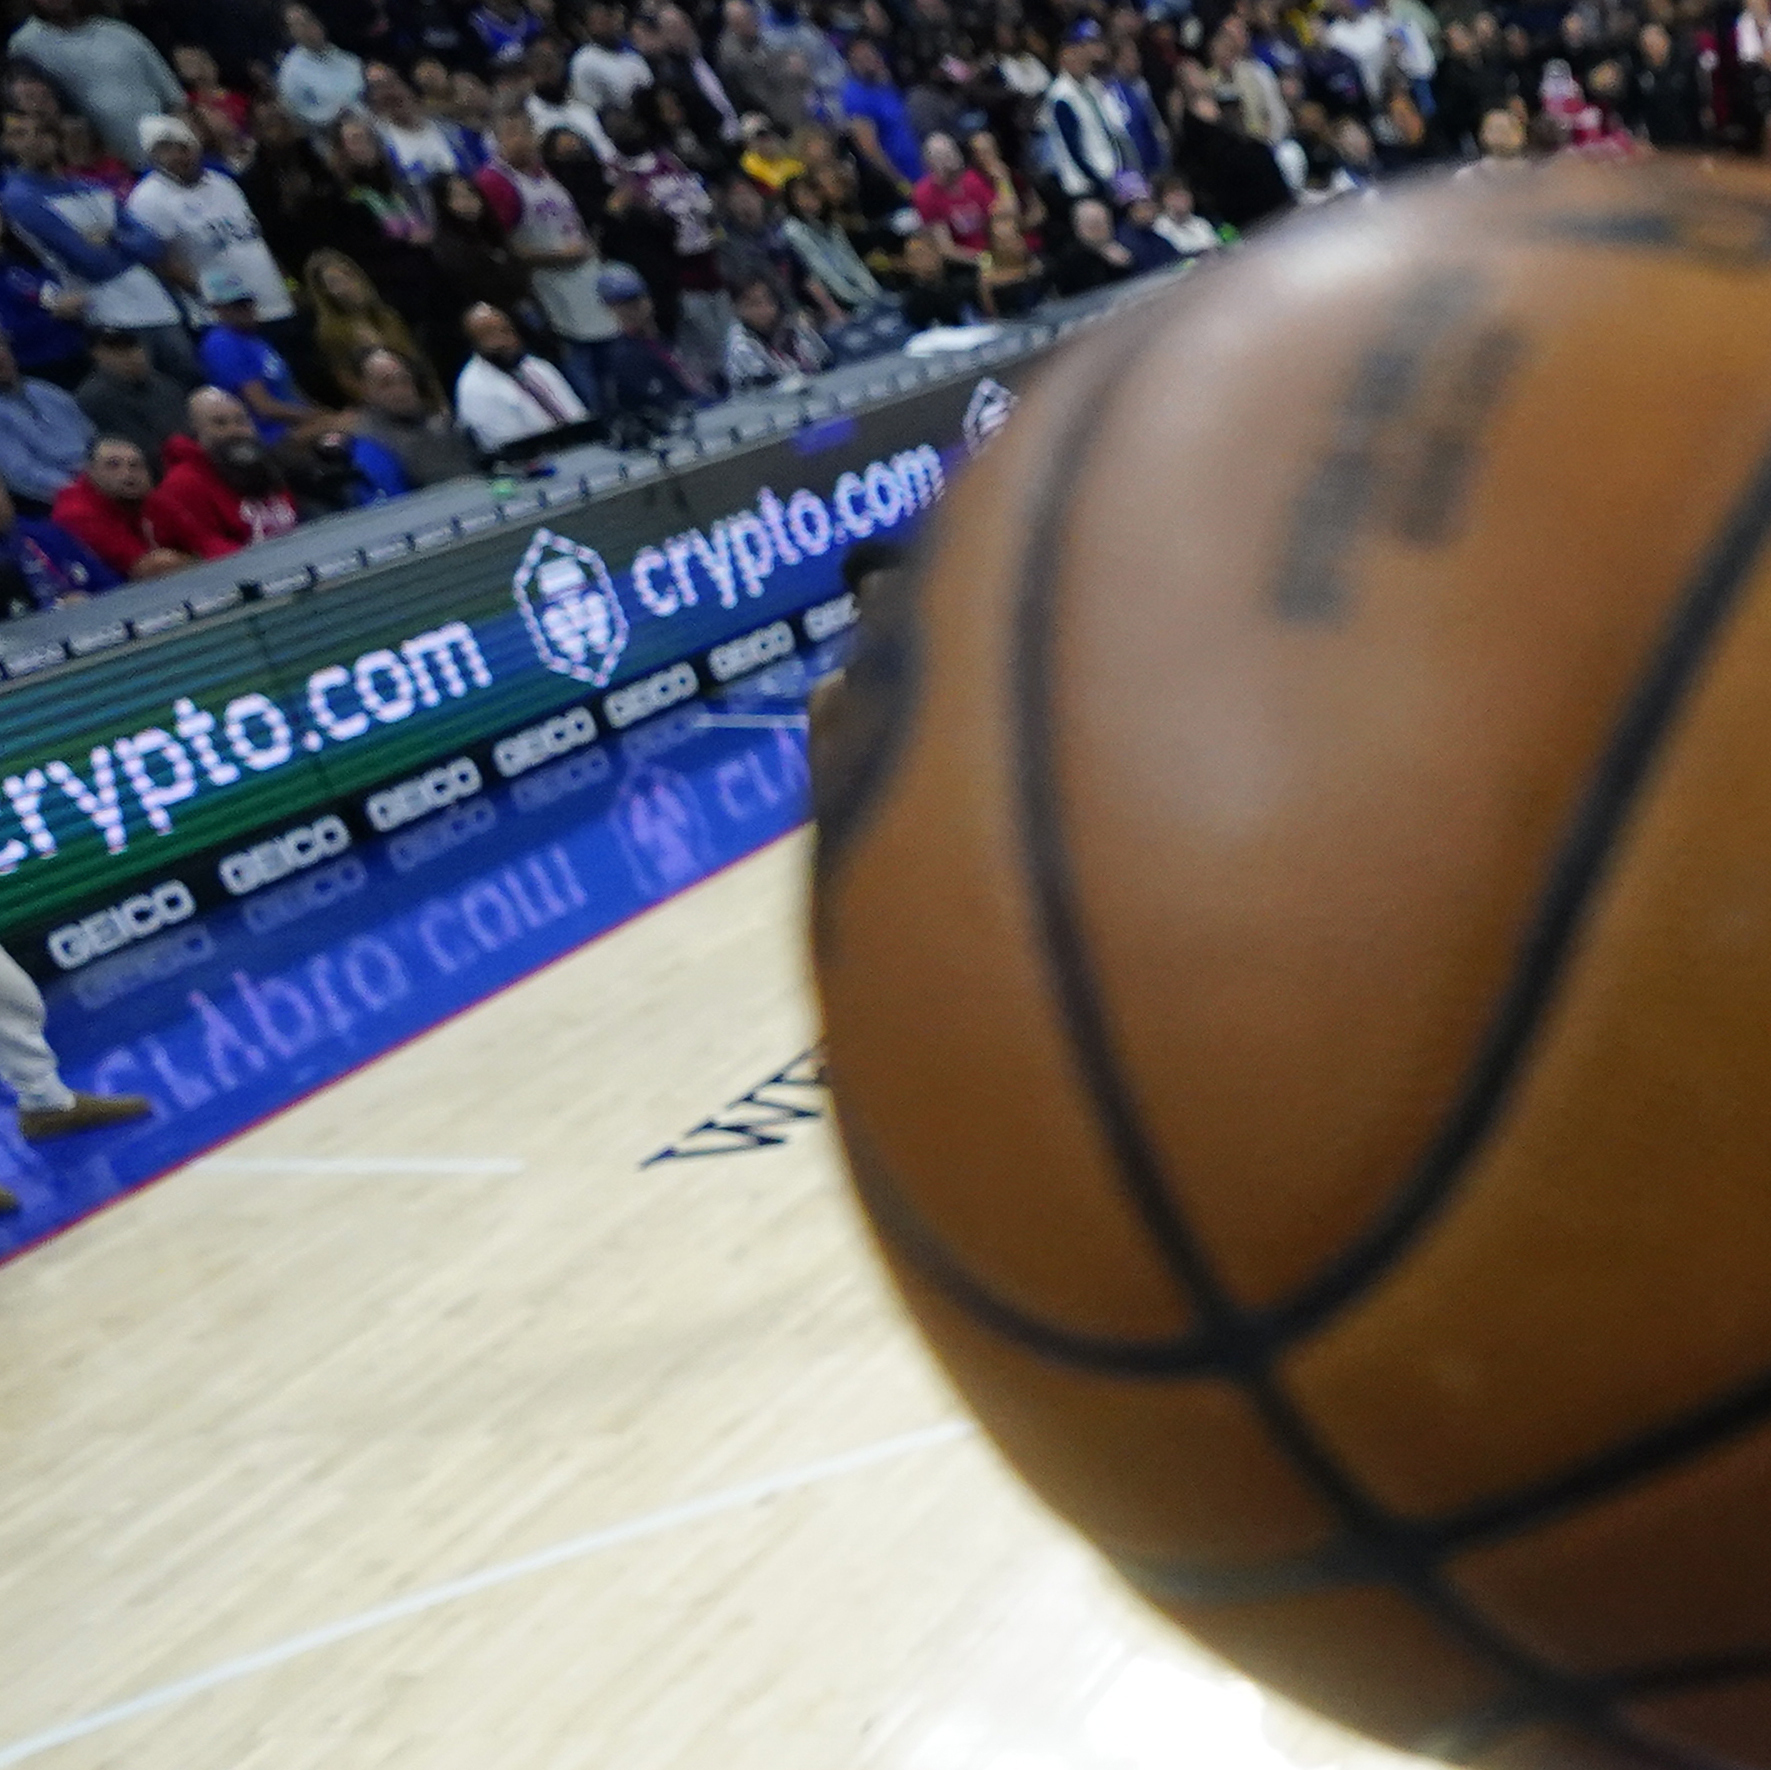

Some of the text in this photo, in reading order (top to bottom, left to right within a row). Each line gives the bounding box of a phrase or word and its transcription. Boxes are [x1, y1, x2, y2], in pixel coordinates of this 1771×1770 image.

[0, 621, 493, 874] rypto.com
[631, 444, 945, 616] crypto.com
[48, 879, 196, 970] GEICO
[219, 815, 351, 895] GEICO
[366, 757, 483, 832] GEICO
[493, 707, 597, 777] GEICO
[603, 662, 699, 729] GEICO
[708, 621, 795, 682] GEICO
